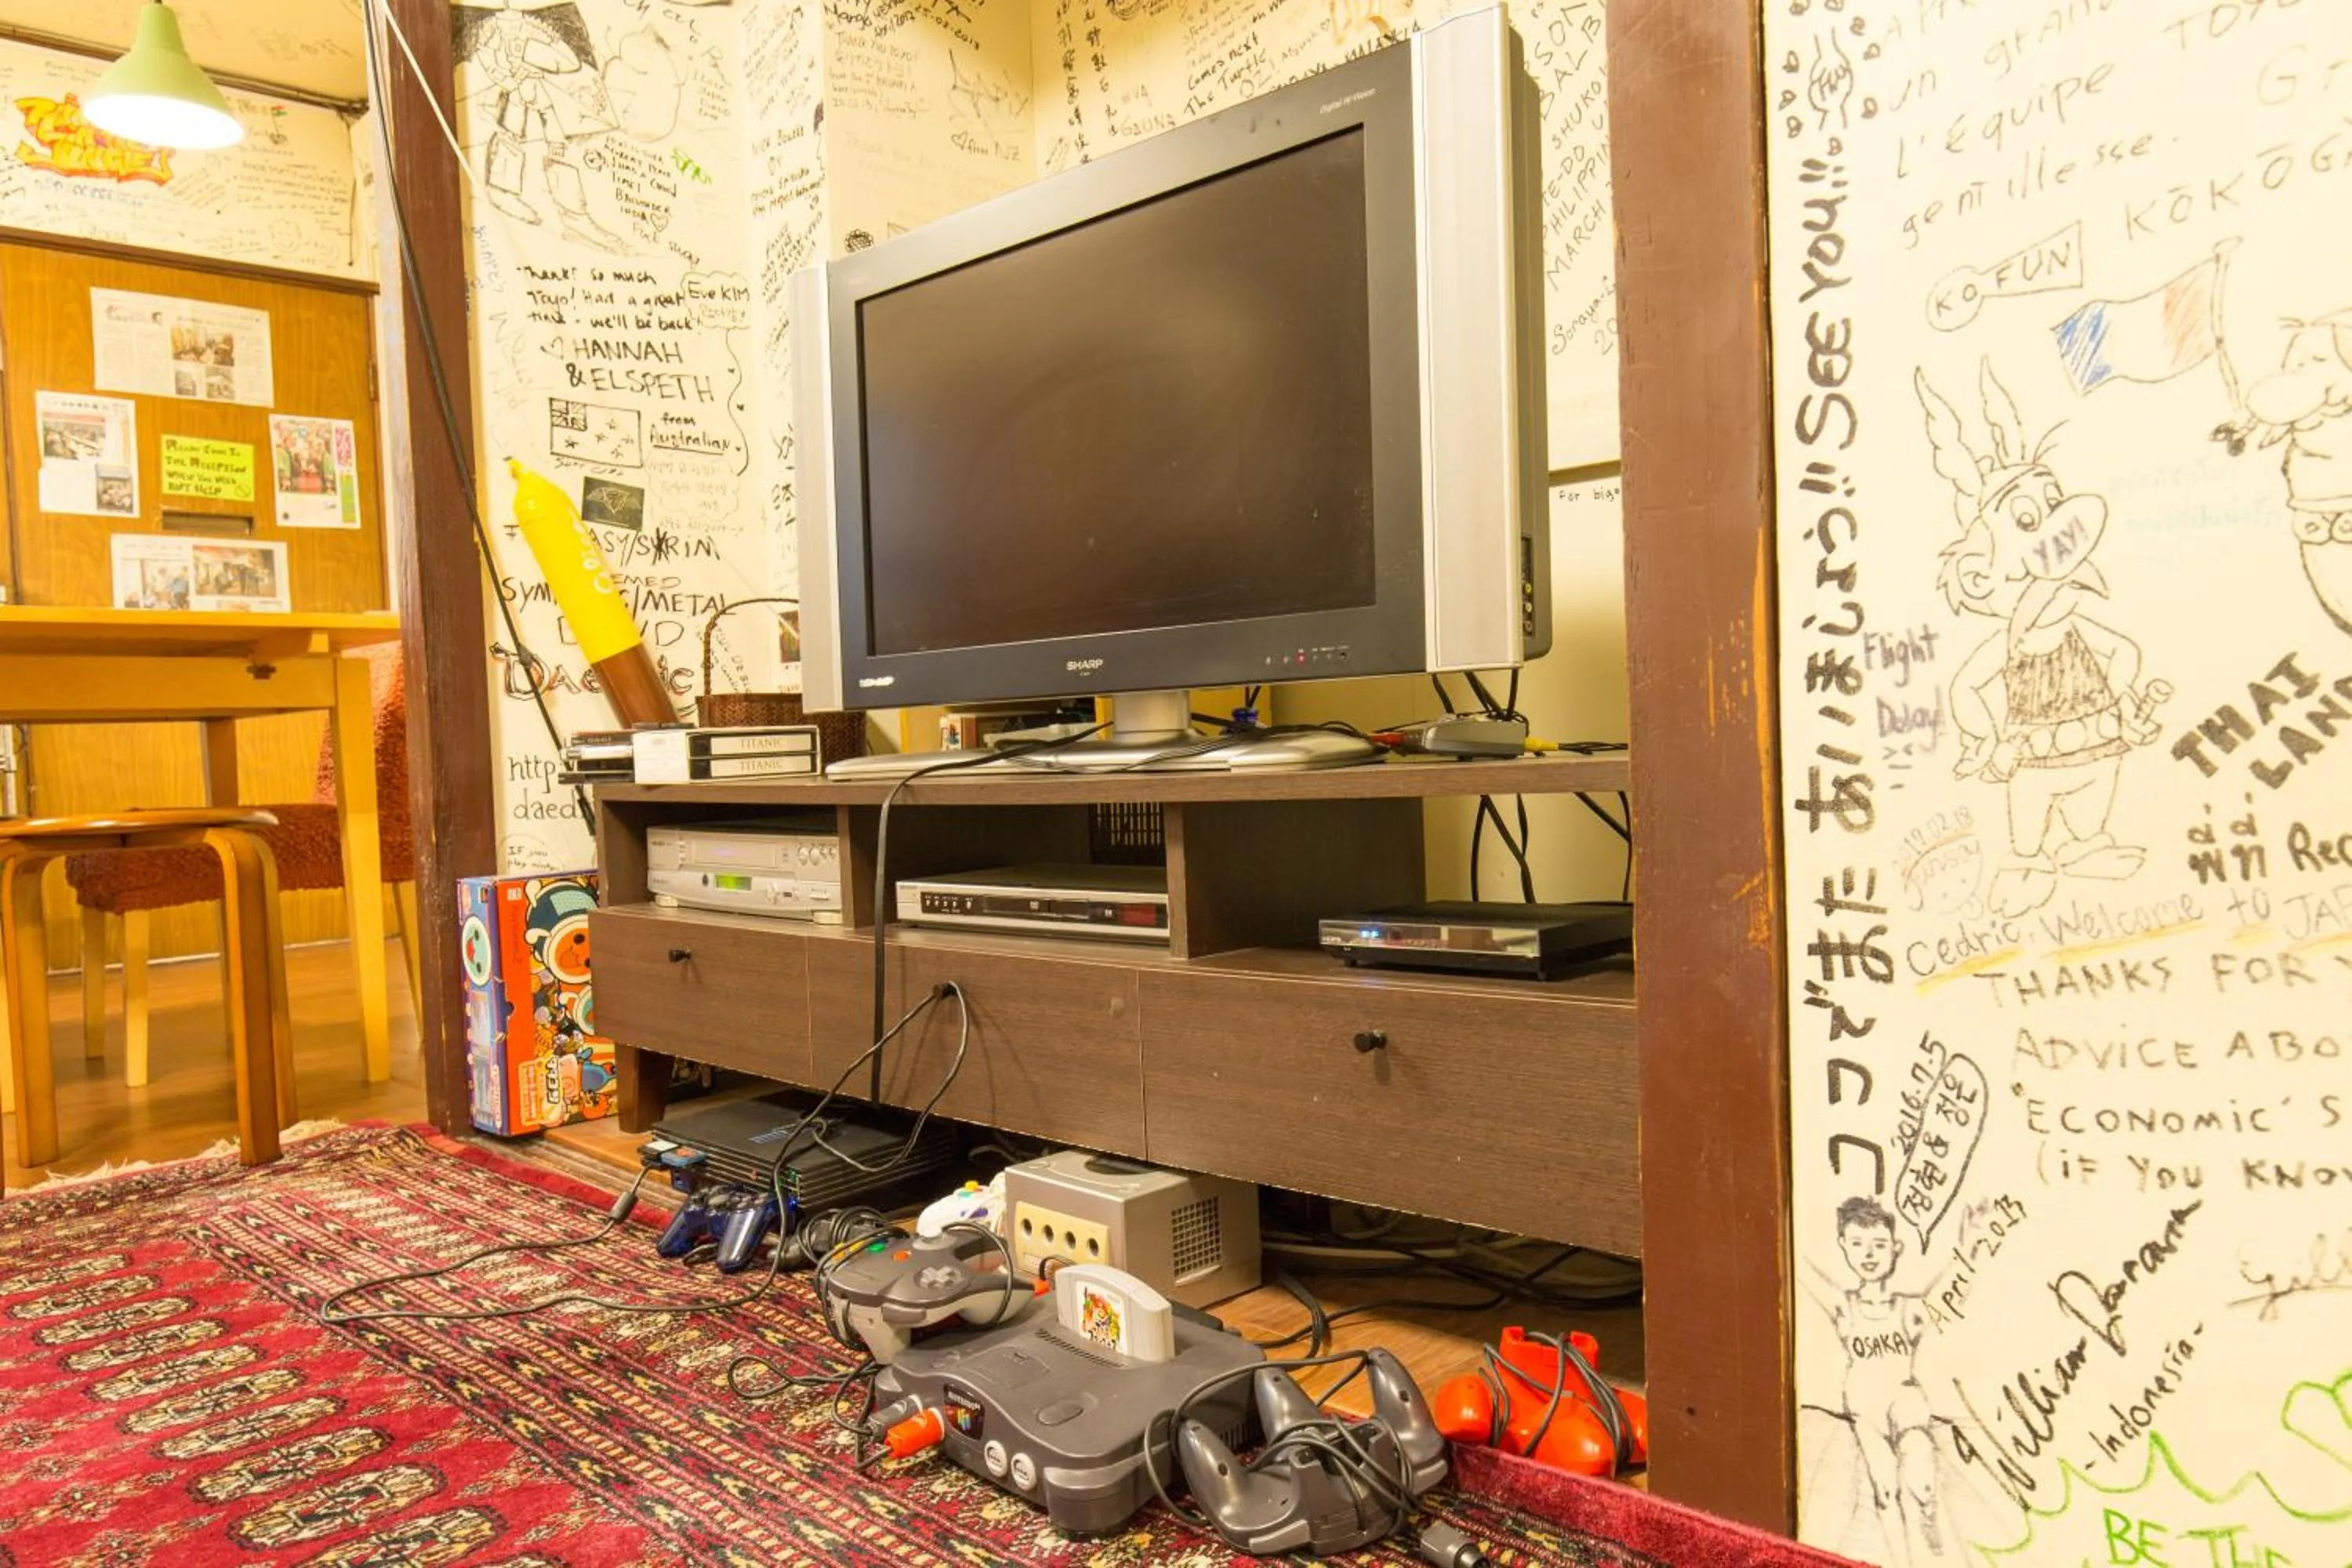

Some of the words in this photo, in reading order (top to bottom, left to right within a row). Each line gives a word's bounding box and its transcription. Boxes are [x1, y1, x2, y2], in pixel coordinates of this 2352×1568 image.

[612, 270, 658, 285] much
[635, 314, 652, 330] be
[572, 337, 685, 365] HANNAH
[565, 362, 586, 389] &
[590, 367, 716, 403] ELSPETH
[662, 411, 697, 427] from
[2032, 515, 2091, 576] YAY!
[1065, 658, 1104, 672] SHARP
[1862, 622, 1940, 688] Flight
[2171, 652, 2321, 778] THAI
[1973, 955, 2173, 1008] THANKS
[2211, 953, 2317, 993] FOR
[1851, 1330, 1910, 1361] OSAKA
[1951, 1335, 2089, 1512] William
[2103, 1507, 2171, 1568] BE
